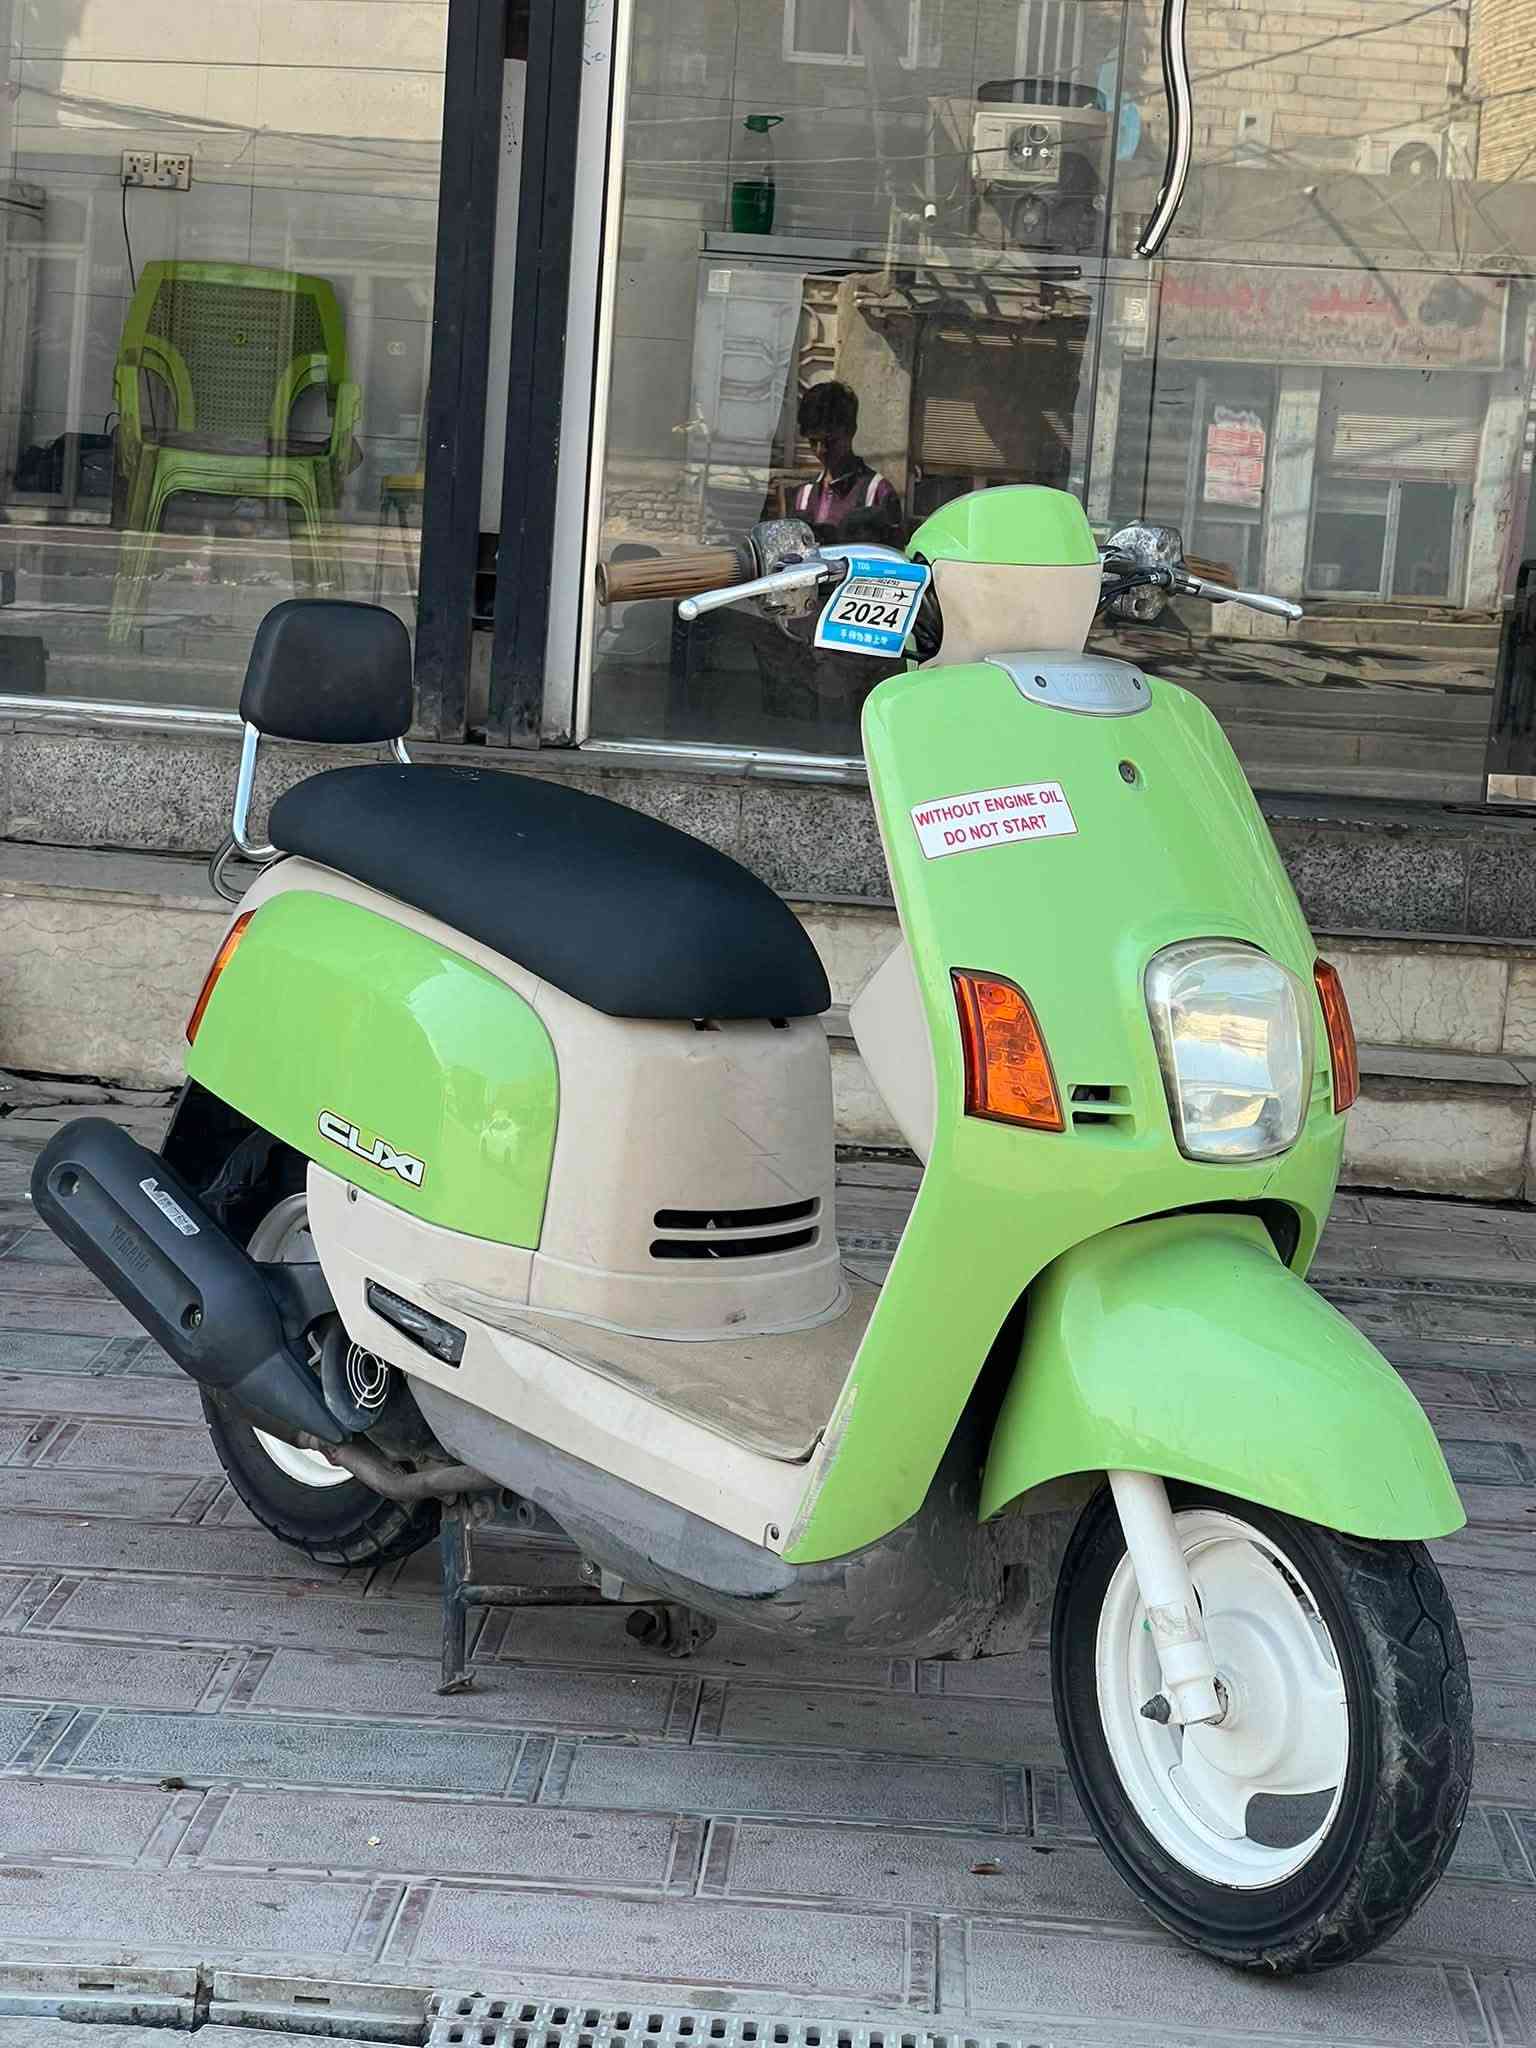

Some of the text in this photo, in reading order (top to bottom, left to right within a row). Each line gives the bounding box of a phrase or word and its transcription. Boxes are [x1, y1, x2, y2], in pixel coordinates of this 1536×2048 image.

[838, 601, 900, 628] 2024
[915, 790, 1063, 826] WITHOUT ENGINE OIL
[943, 814, 1048, 846] DO NOT START
[318, 1110, 425, 1187] CUXI
